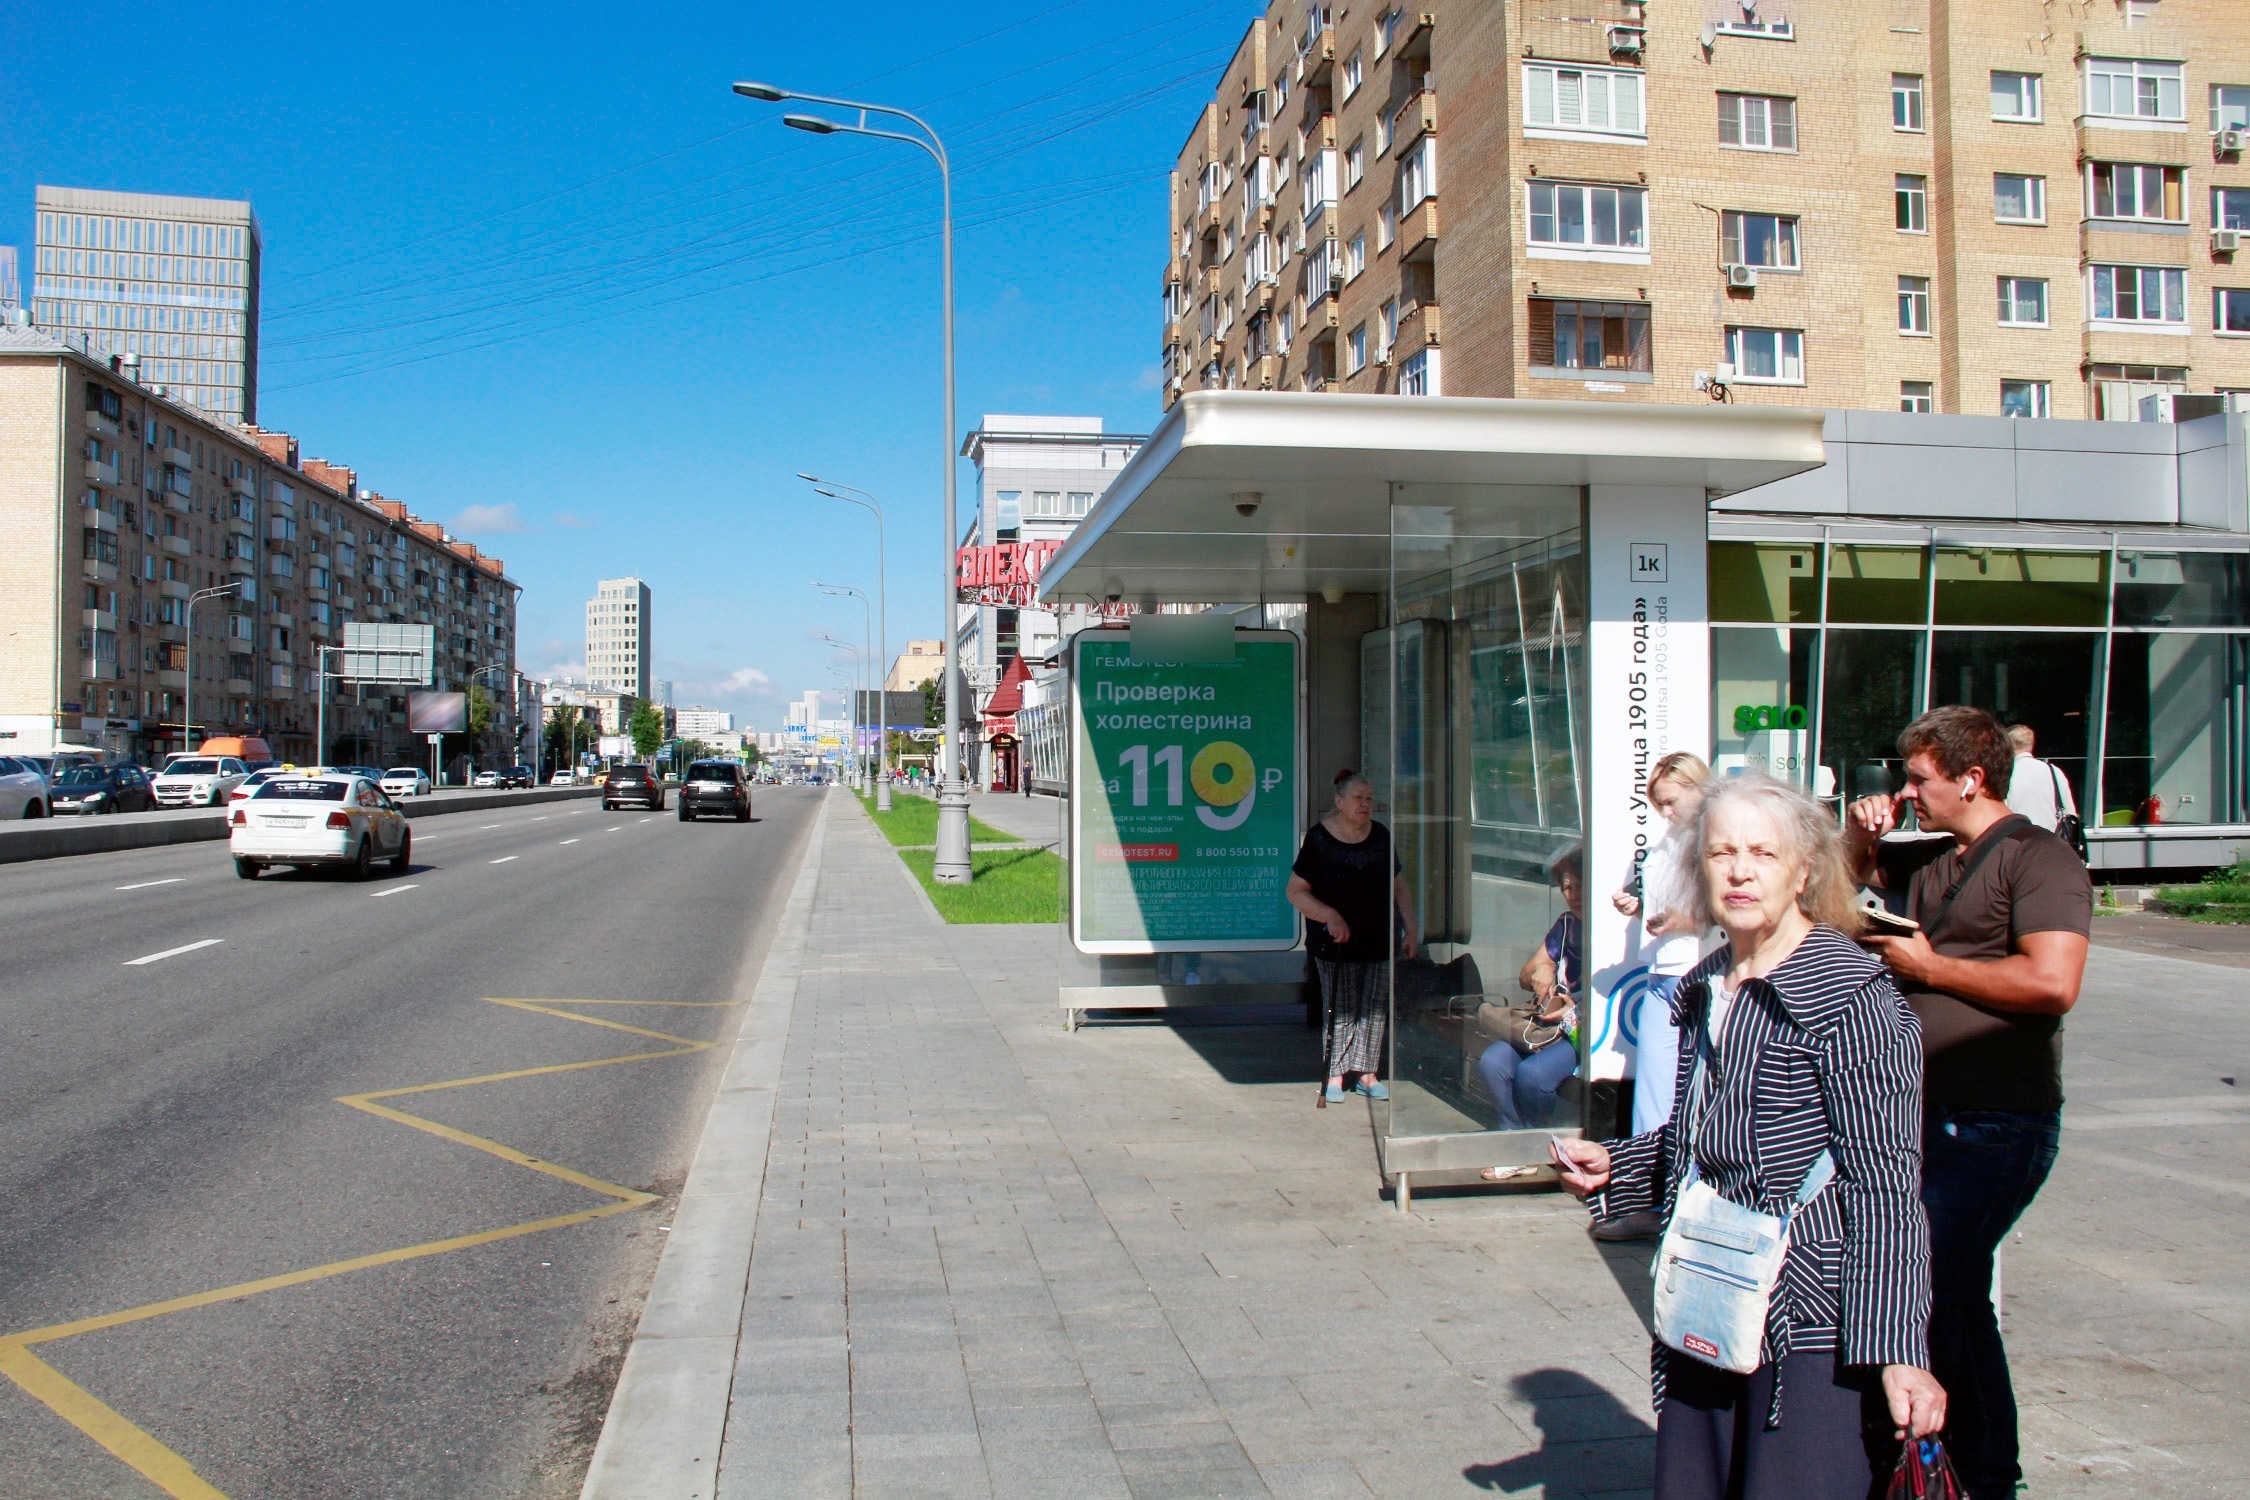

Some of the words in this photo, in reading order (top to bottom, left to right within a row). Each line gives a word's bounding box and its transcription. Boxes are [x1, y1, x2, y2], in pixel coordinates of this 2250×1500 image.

[1632, 597, 1649, 664] года»
[1654, 596, 1668, 638] Goda
[1655, 643, 1668, 682] 1905
[1096, 681, 1215, 705] Проверка
[1629, 671, 1647, 730] 1905
[1655, 687, 1668, 730] Ulitsa
[1096, 713, 1252, 734] холестерина
[1657, 735, 1668, 756] tro
[1096, 778, 1120, 794] за
[1119, 740, 1257, 831] 119
[1630, 738, 1649, 826] «Улица
[1137, 826, 1173, 834] подарок
[1101, 848, 1172, 857] GEMOTEST.RU
[1196, 847, 1203, 857] 8
[1205, 847, 1227, 857] 800
[1229, 847, 1250, 857] 550
[1253, 847, 1264, 857] 13
[1267, 847, 1279, 857] 13
[1634, 833, 1647, 895] етро
